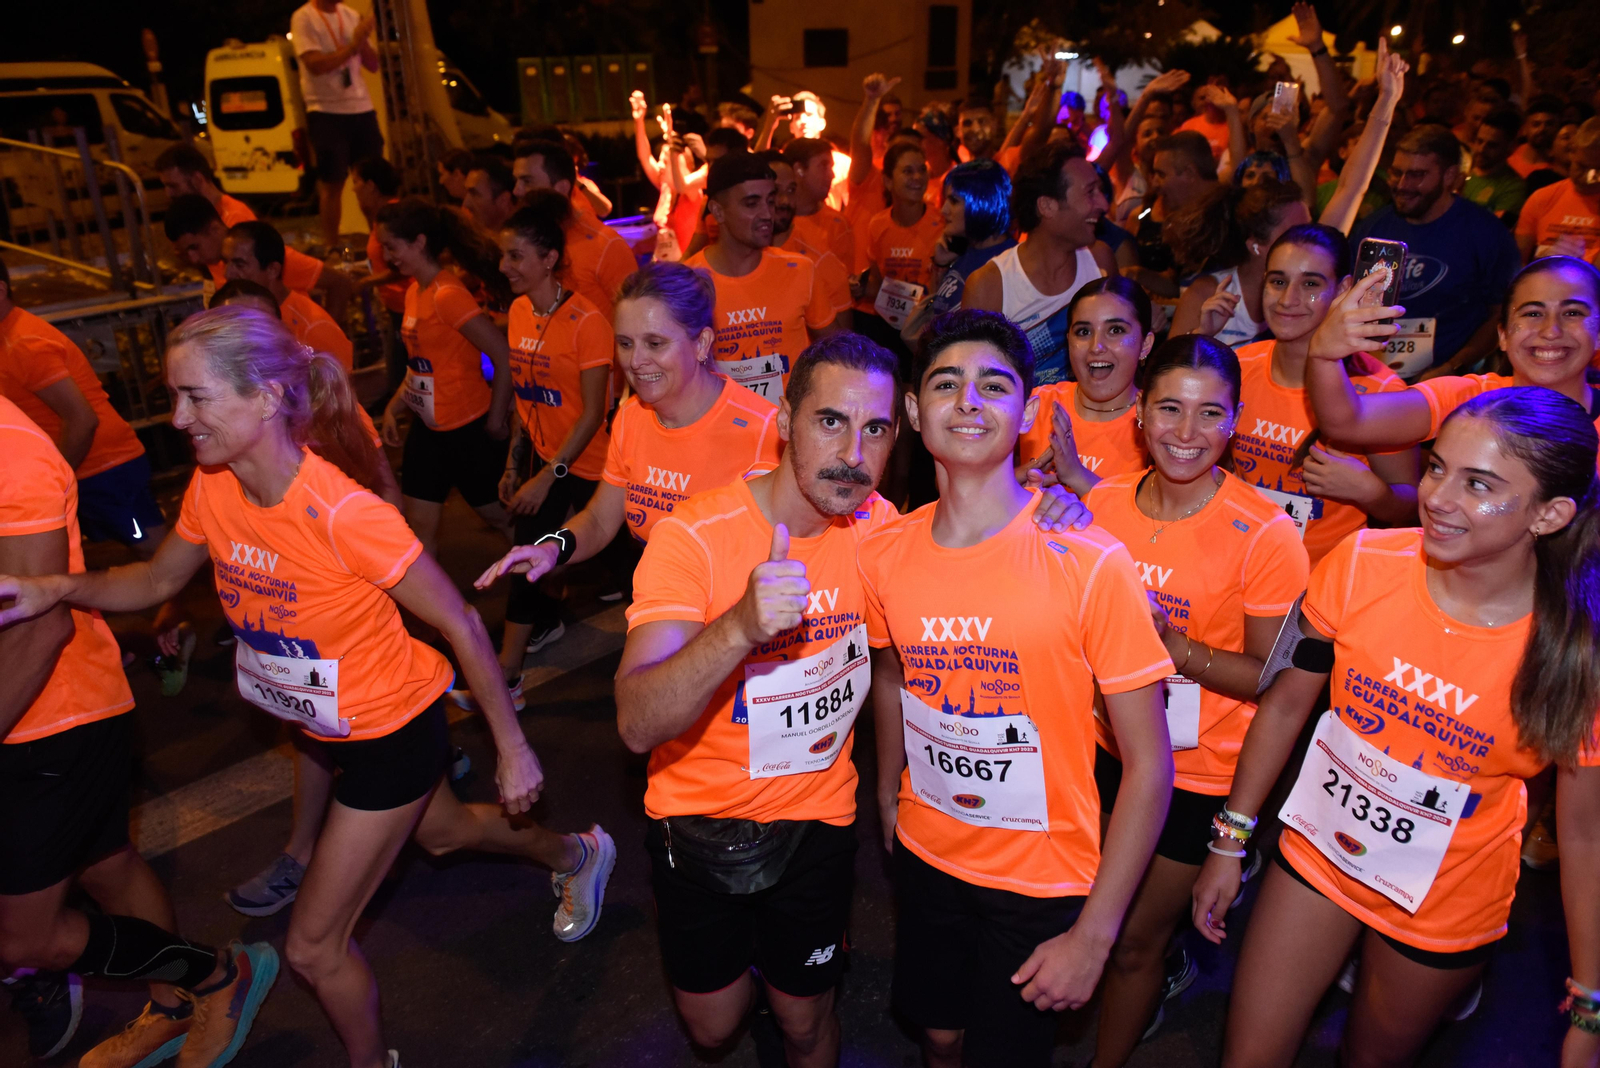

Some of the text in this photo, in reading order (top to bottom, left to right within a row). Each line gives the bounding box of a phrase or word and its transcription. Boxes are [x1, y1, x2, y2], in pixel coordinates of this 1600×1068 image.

[890, 247, 914, 257] XXXV
[726, 306, 767, 325] XXXV
[887, 296, 906, 311] 7934
[717, 326, 783, 342] GUADALQUIVIR
[746, 320, 782, 330] NOCTURNA
[744, 382, 770, 396] 77
[1251, 418, 1305, 446] XXXV
[1077, 454, 1104, 472] XV
[626, 482, 658, 497] CARRERA
[645, 465, 691, 493] XXXV
[230, 540, 279, 573] XXXV
[218, 569, 298, 603] GUADALQUIVIR
[248, 571, 297, 591] NOCTURNA
[803, 587, 839, 615] XV
[802, 612, 860, 628] NOCTURNA
[920, 616, 993, 642] XXXV
[900, 644, 1019, 661] CARRERA NOCTURNA
[911, 657, 1020, 675] GUADALQUIVIR
[771, 693, 795, 702] CARRERA
[1383, 656, 1480, 716] XXXV
[255, 683, 316, 718] 11920
[780, 678, 854, 728] 11884
[1347, 668, 1495, 745] CARRERA NOCTURNA
[781, 707, 854, 739] MANUEL GORDILLO MORENO
[1344, 678, 1490, 757] DEL GUADALQUIVIR
[924, 744, 1012, 782] 16667
[1322, 768, 1415, 843] 21338
